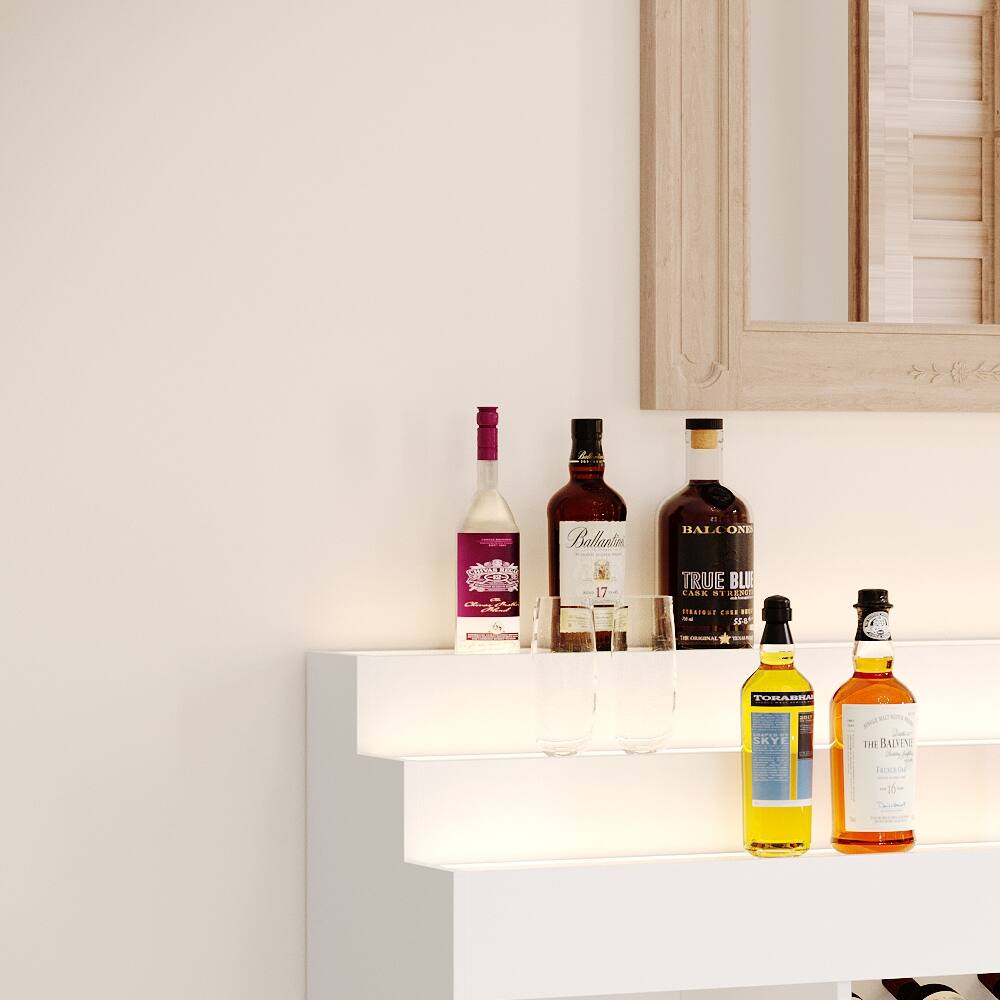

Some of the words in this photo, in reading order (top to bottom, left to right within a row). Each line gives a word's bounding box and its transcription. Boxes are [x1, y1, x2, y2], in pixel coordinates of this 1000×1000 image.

[682, 571, 725, 590] TRUE
[596, 586, 608, 598] 17
[864, 740, 879, 748] THE
